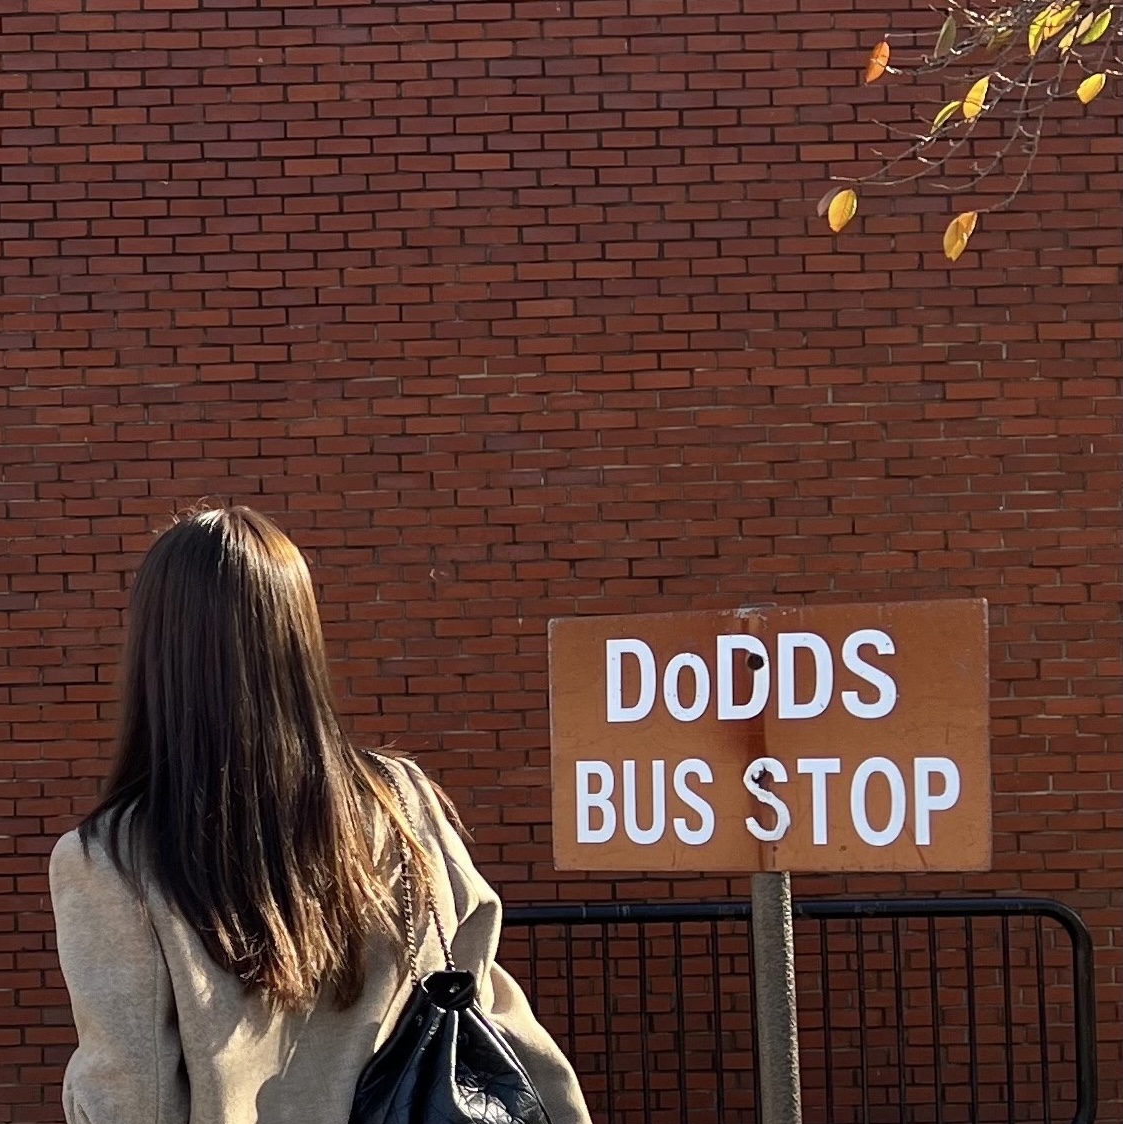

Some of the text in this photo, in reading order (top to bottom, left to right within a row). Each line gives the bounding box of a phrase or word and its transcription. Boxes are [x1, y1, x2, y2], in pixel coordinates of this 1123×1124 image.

[605, 628, 898, 723] DoDDS
[575, 756, 962, 848] BUS STOP
